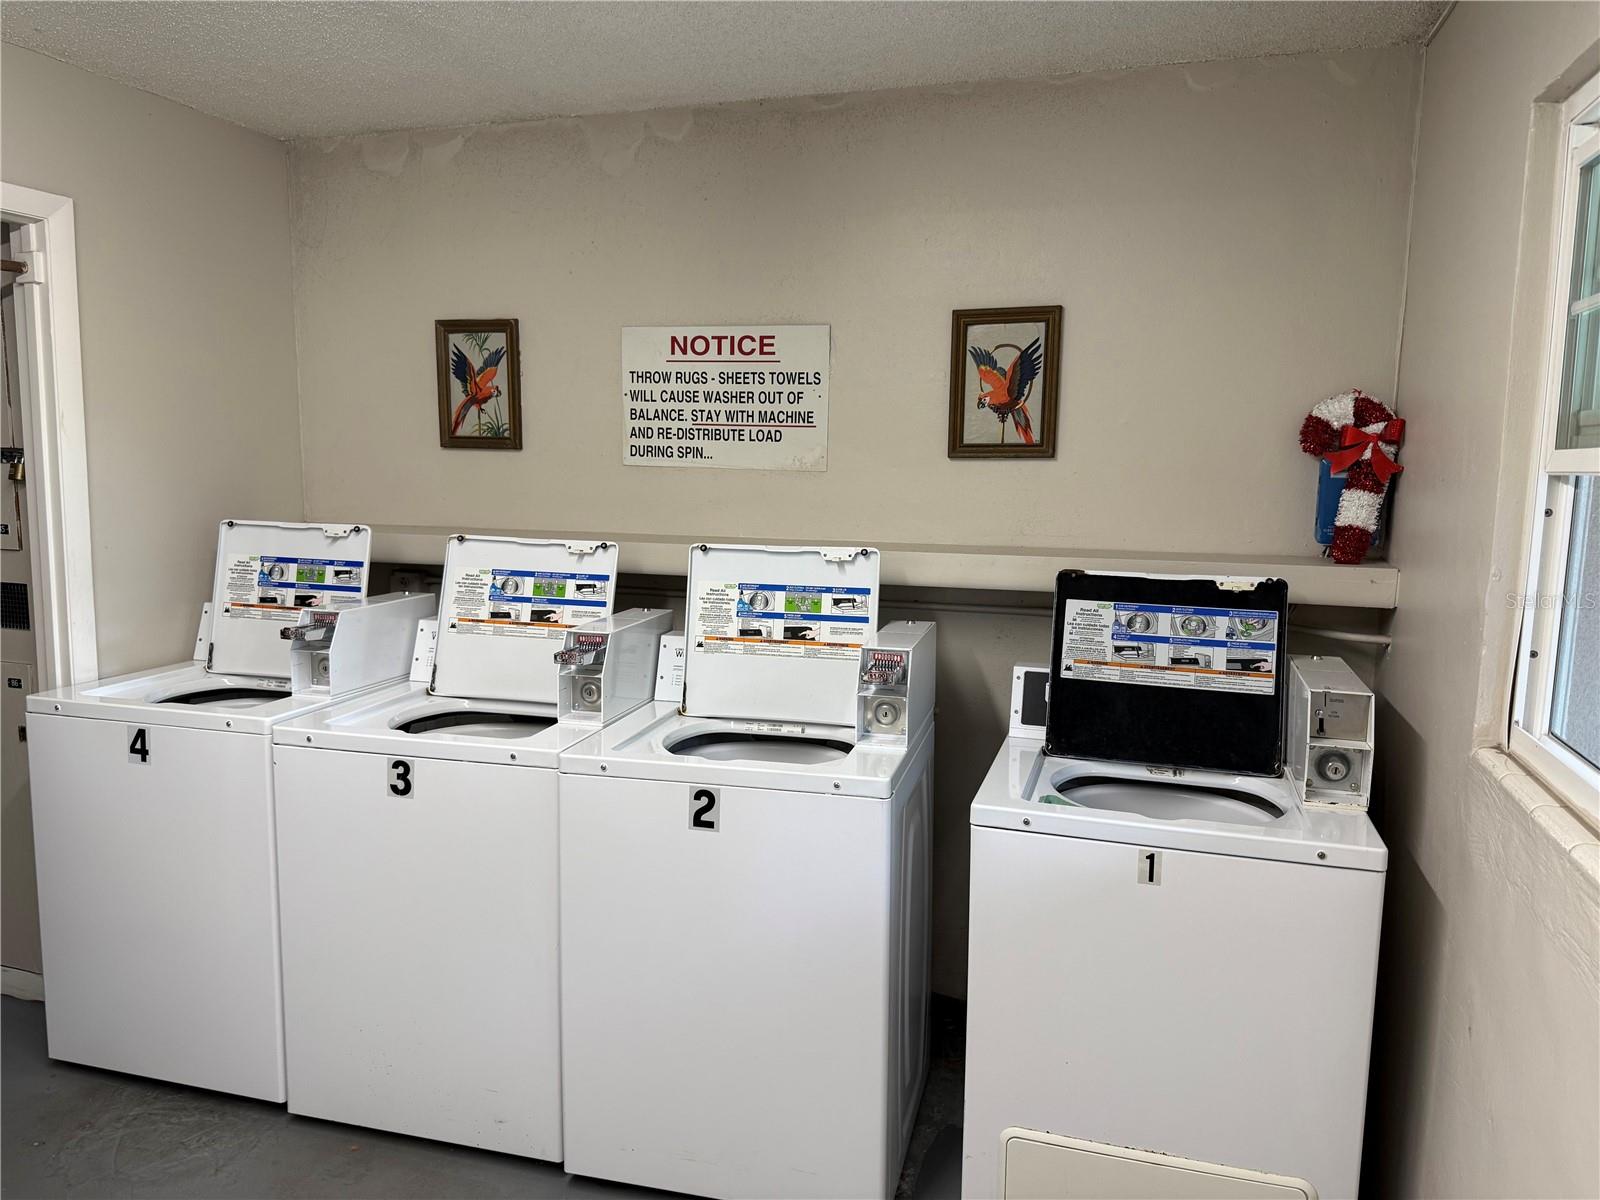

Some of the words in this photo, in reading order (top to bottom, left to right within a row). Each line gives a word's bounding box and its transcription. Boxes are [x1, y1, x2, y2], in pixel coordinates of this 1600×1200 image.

[670, 335, 776, 356] NOTICE
[629, 371, 672, 384] THROW
[675, 371, 708, 384] RUGS
[718, 372, 766, 385] SHEETS
[769, 372, 822, 386] TOWELS
[630, 390, 656, 402] WILL
[660, 390, 700, 404] CAUSE
[702, 390, 754, 404] WASHER
[758, 391, 782, 404] OUT
[786, 391, 804, 404] OF
[630, 408, 688, 422] BALANCE.
[691, 409, 722, 422] STAY
[724, 410, 754, 423] WITH
[758, 410, 814, 424] MACHINE
[630, 427, 654, 440] AND
[657, 428, 745, 442] RE-DISTRIBUTE
[749, 429, 782, 442] LOAD
[630, 445, 674, 458] DURING
[676, 446, 713, 460] SPIN...
[130, 728, 150, 762] 4
[390, 760, 412, 796] 3
[693, 790, 716, 829] 2
[1146, 853, 1155, 883] 1
